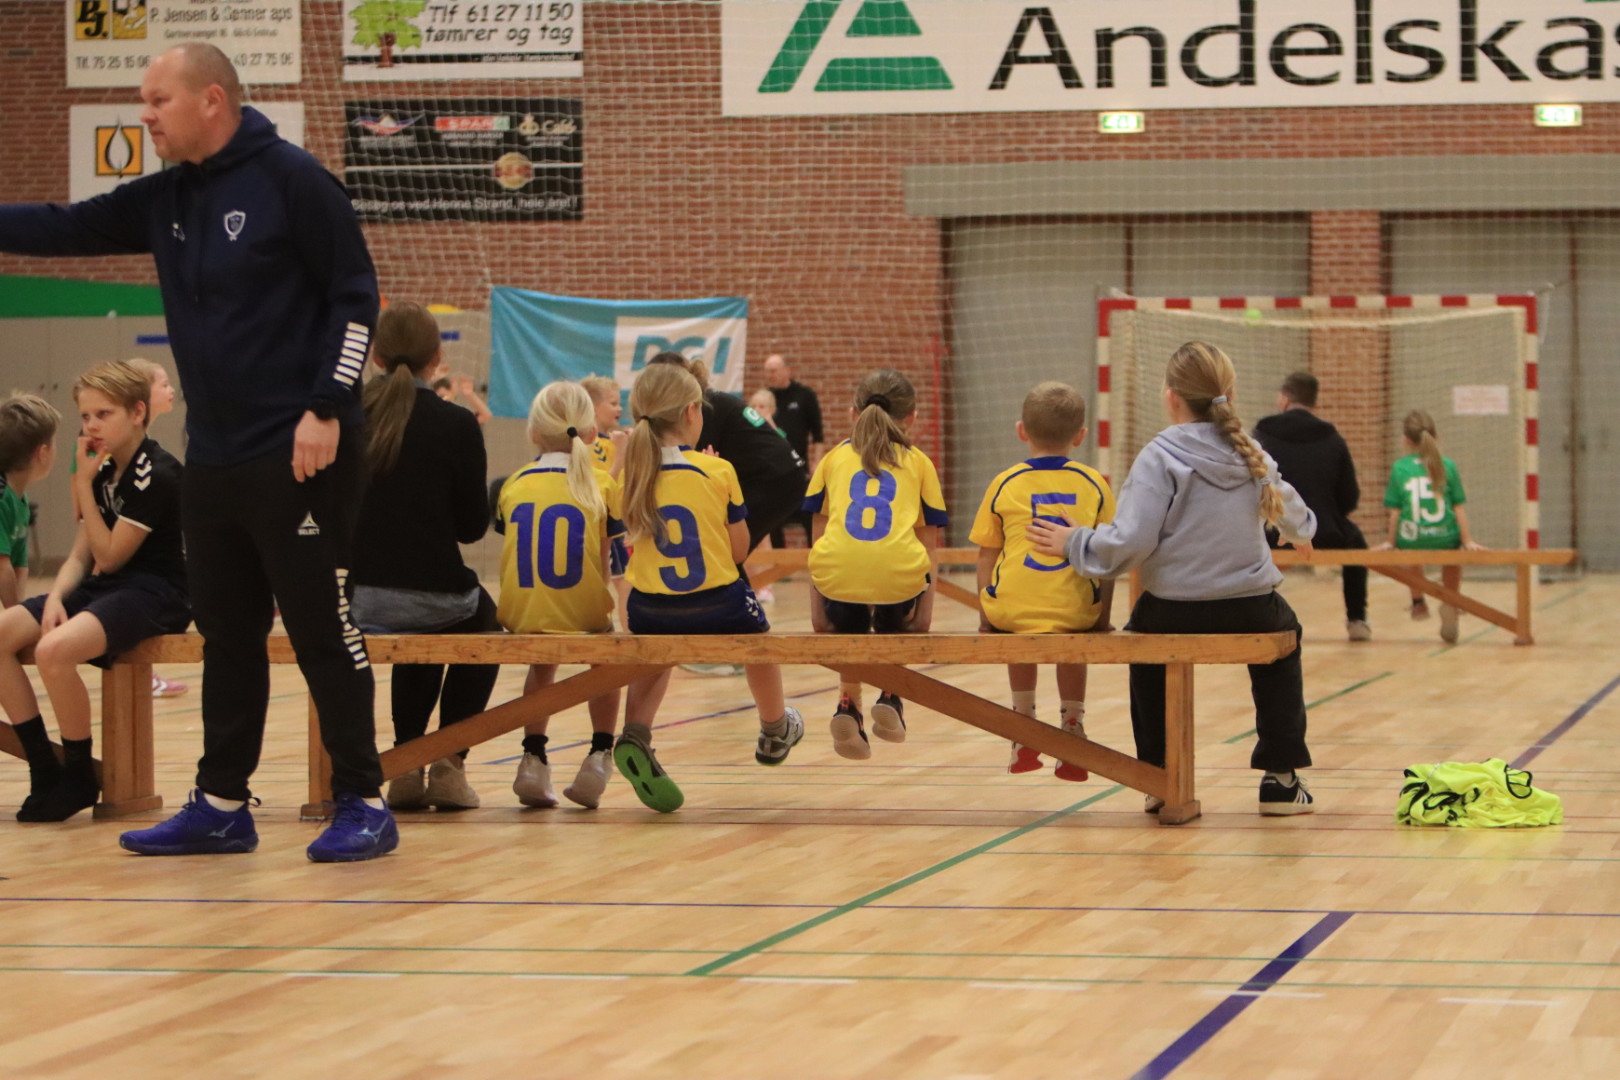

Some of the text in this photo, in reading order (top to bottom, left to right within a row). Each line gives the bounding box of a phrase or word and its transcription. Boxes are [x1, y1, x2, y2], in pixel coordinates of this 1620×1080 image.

[164, 8, 207, 23] Jensen
[210, 6, 219, 21] &
[270, 7, 293, 23] aps
[425, 24, 574, 46] tømrer og tag
[430, 2, 575, 22] Tlf 61 27 11 50
[988, 0, 1620, 91] Andelska
[845, 469, 897, 542] 8
[1022, 493, 1077, 572] 5
[1405, 476, 1447, 524] 15
[510, 502, 586, 590] 10
[653, 504, 707, 592] 9
